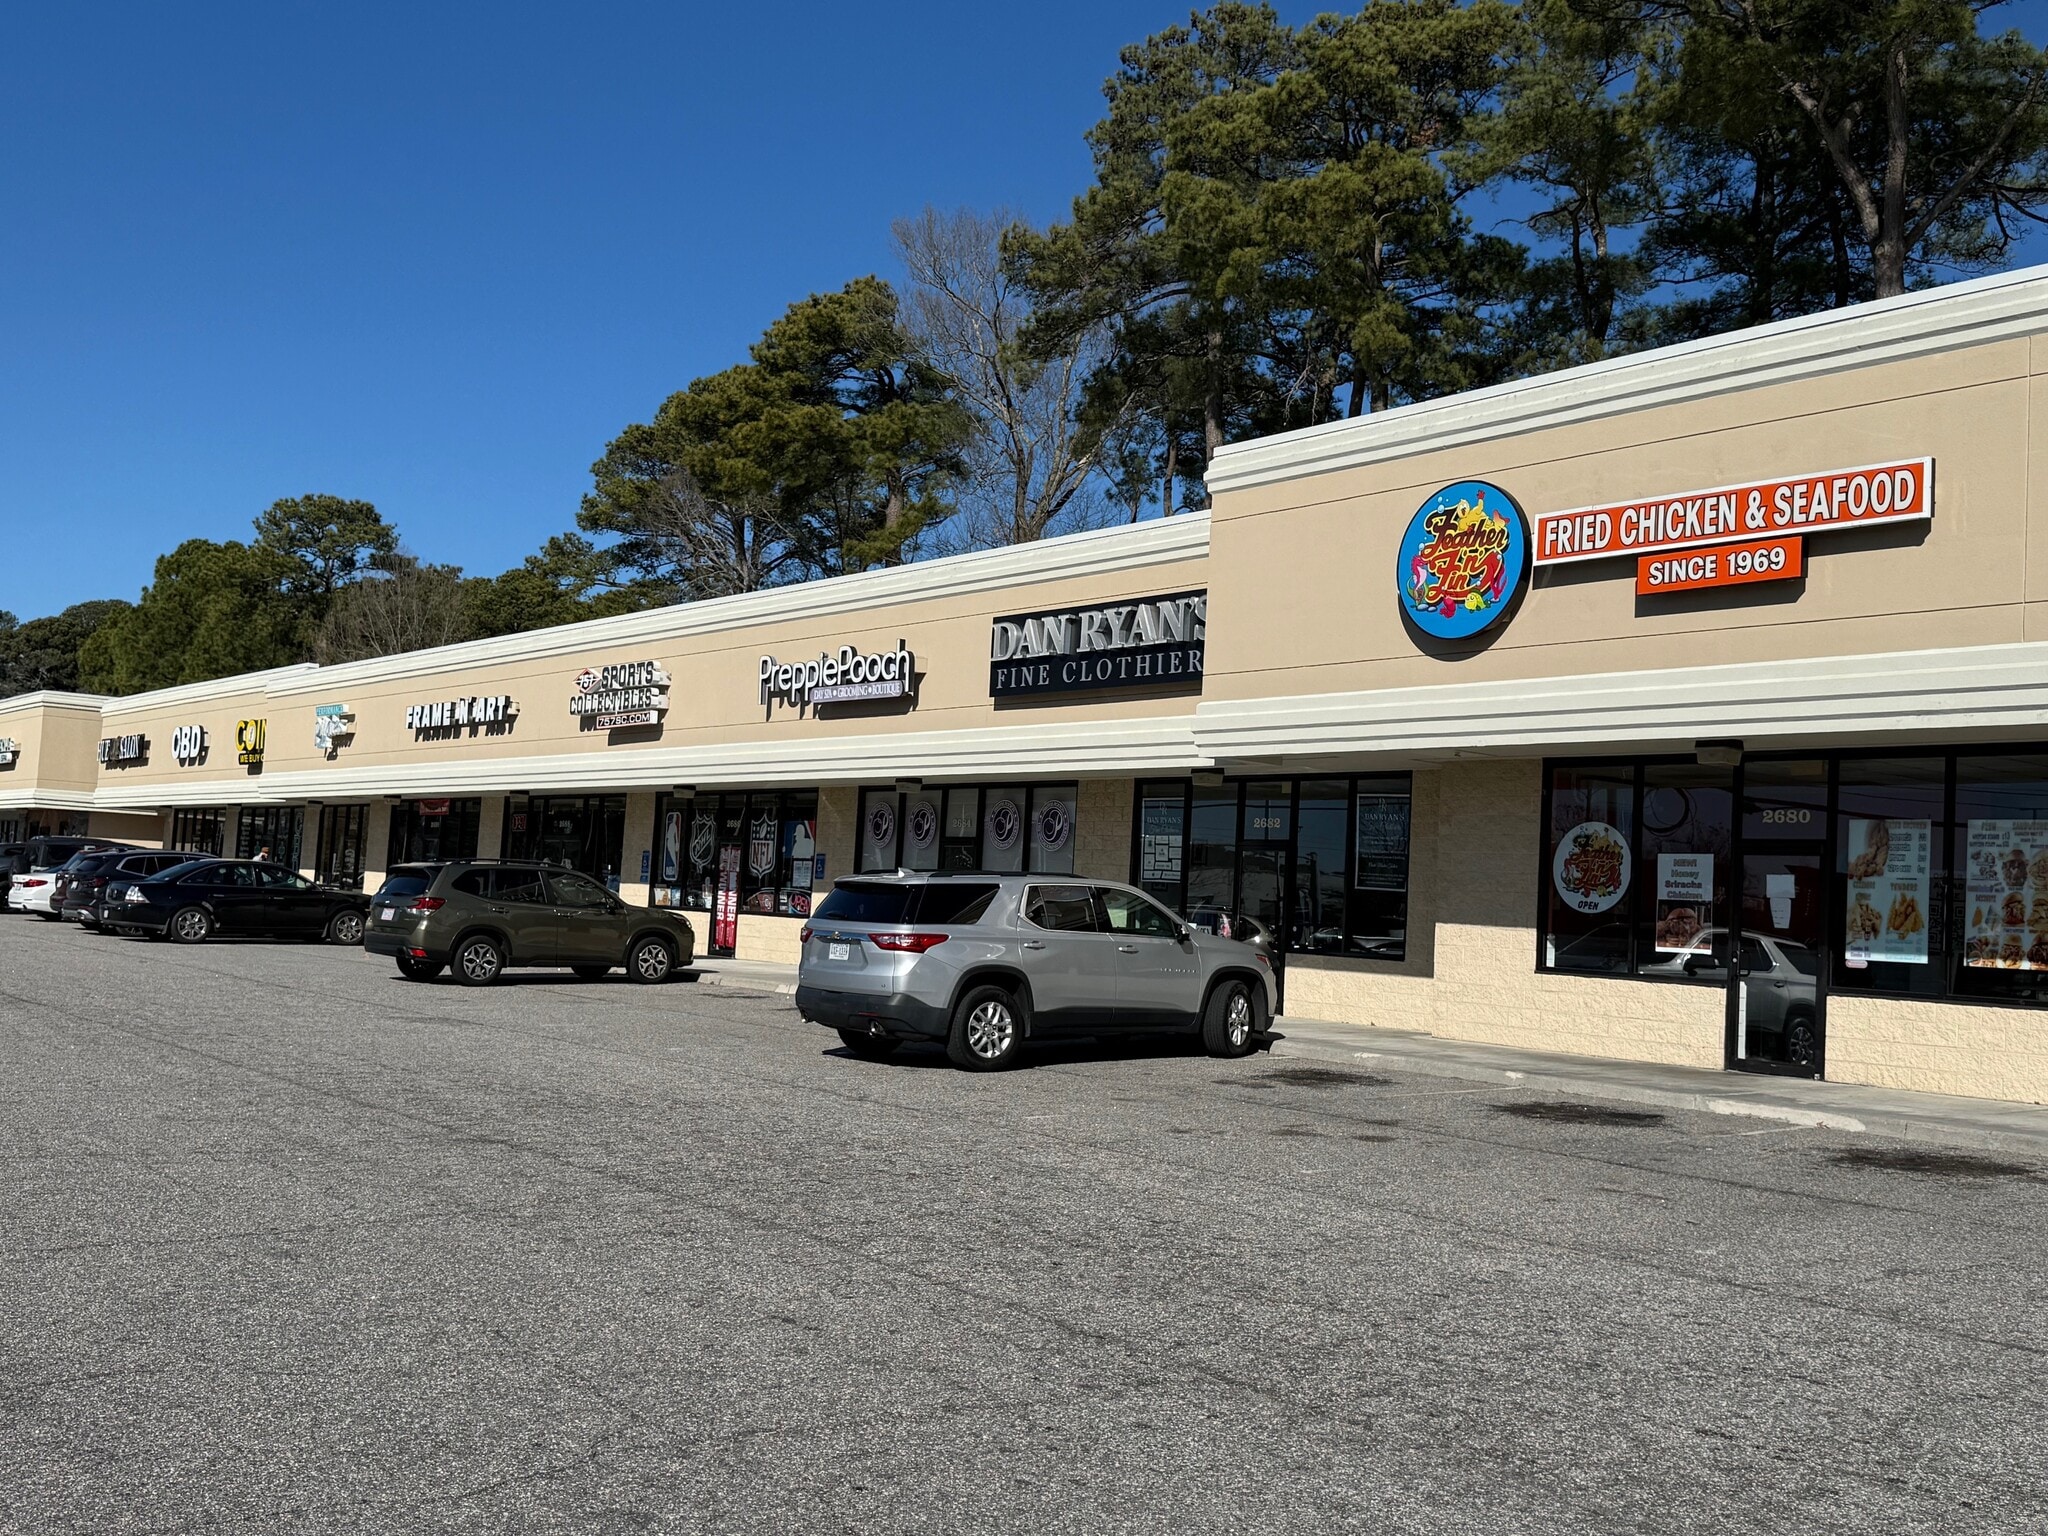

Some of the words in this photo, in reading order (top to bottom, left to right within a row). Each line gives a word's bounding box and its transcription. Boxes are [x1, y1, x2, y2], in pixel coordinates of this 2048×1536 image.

[1544, 514, 1611, 556] FRIED
[1619, 493, 1736, 546] CHICKEN
[1744, 489, 1768, 530] &
[1772, 469, 1916, 529] SEAFOOD
[1420, 504, 1509, 560] Feather
[1647, 555, 1717, 586] SINCE
[1726, 546, 1786, 576] 1969
[990, 614, 1071, 662] DAN
[1076, 595, 1207, 653] RYAN'S
[601, 661, 654, 689] SPORTS
[996, 664, 1050, 689] FINE
[569, 688, 653, 715] COLLECTIBLES
[837, 684, 868, 698] GROOMING
[872, 682, 901, 696] BOUTIQUE
[405, 702, 452, 729] FRAME
[475, 696, 505, 722] ART
[597, 712, 651, 728] 757SC.COM
[249, 753, 261, 763] BUY
[1253, 817, 1281, 829] 2682
[1762, 809, 1811, 824] 2680
[694, 831, 711, 855] NHL
[752, 841, 773, 869] NFL
[1664, 880, 1703, 889] Sriracha
[1577, 900, 1600, 911] OPEN
